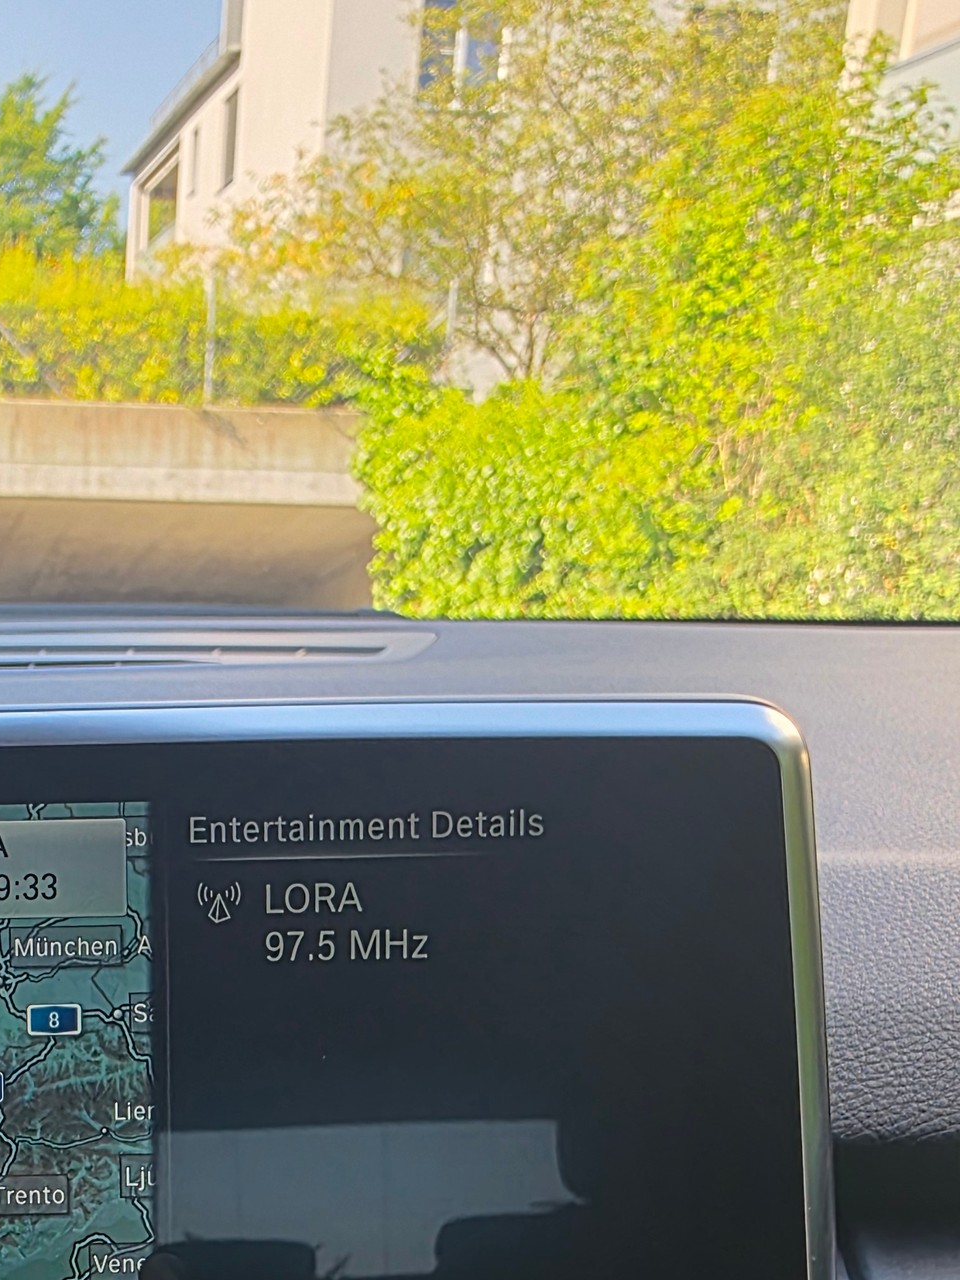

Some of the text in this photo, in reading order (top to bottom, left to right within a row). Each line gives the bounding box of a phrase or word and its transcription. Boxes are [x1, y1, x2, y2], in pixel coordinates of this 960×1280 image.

[188, 809, 546, 845] Entertainment Details
[264, 881, 364, 916] LORA
[13, 937, 119, 959] München
[264, 928, 430, 964] 97.5 MHz
[48, 1012, 60, 1030] 8
